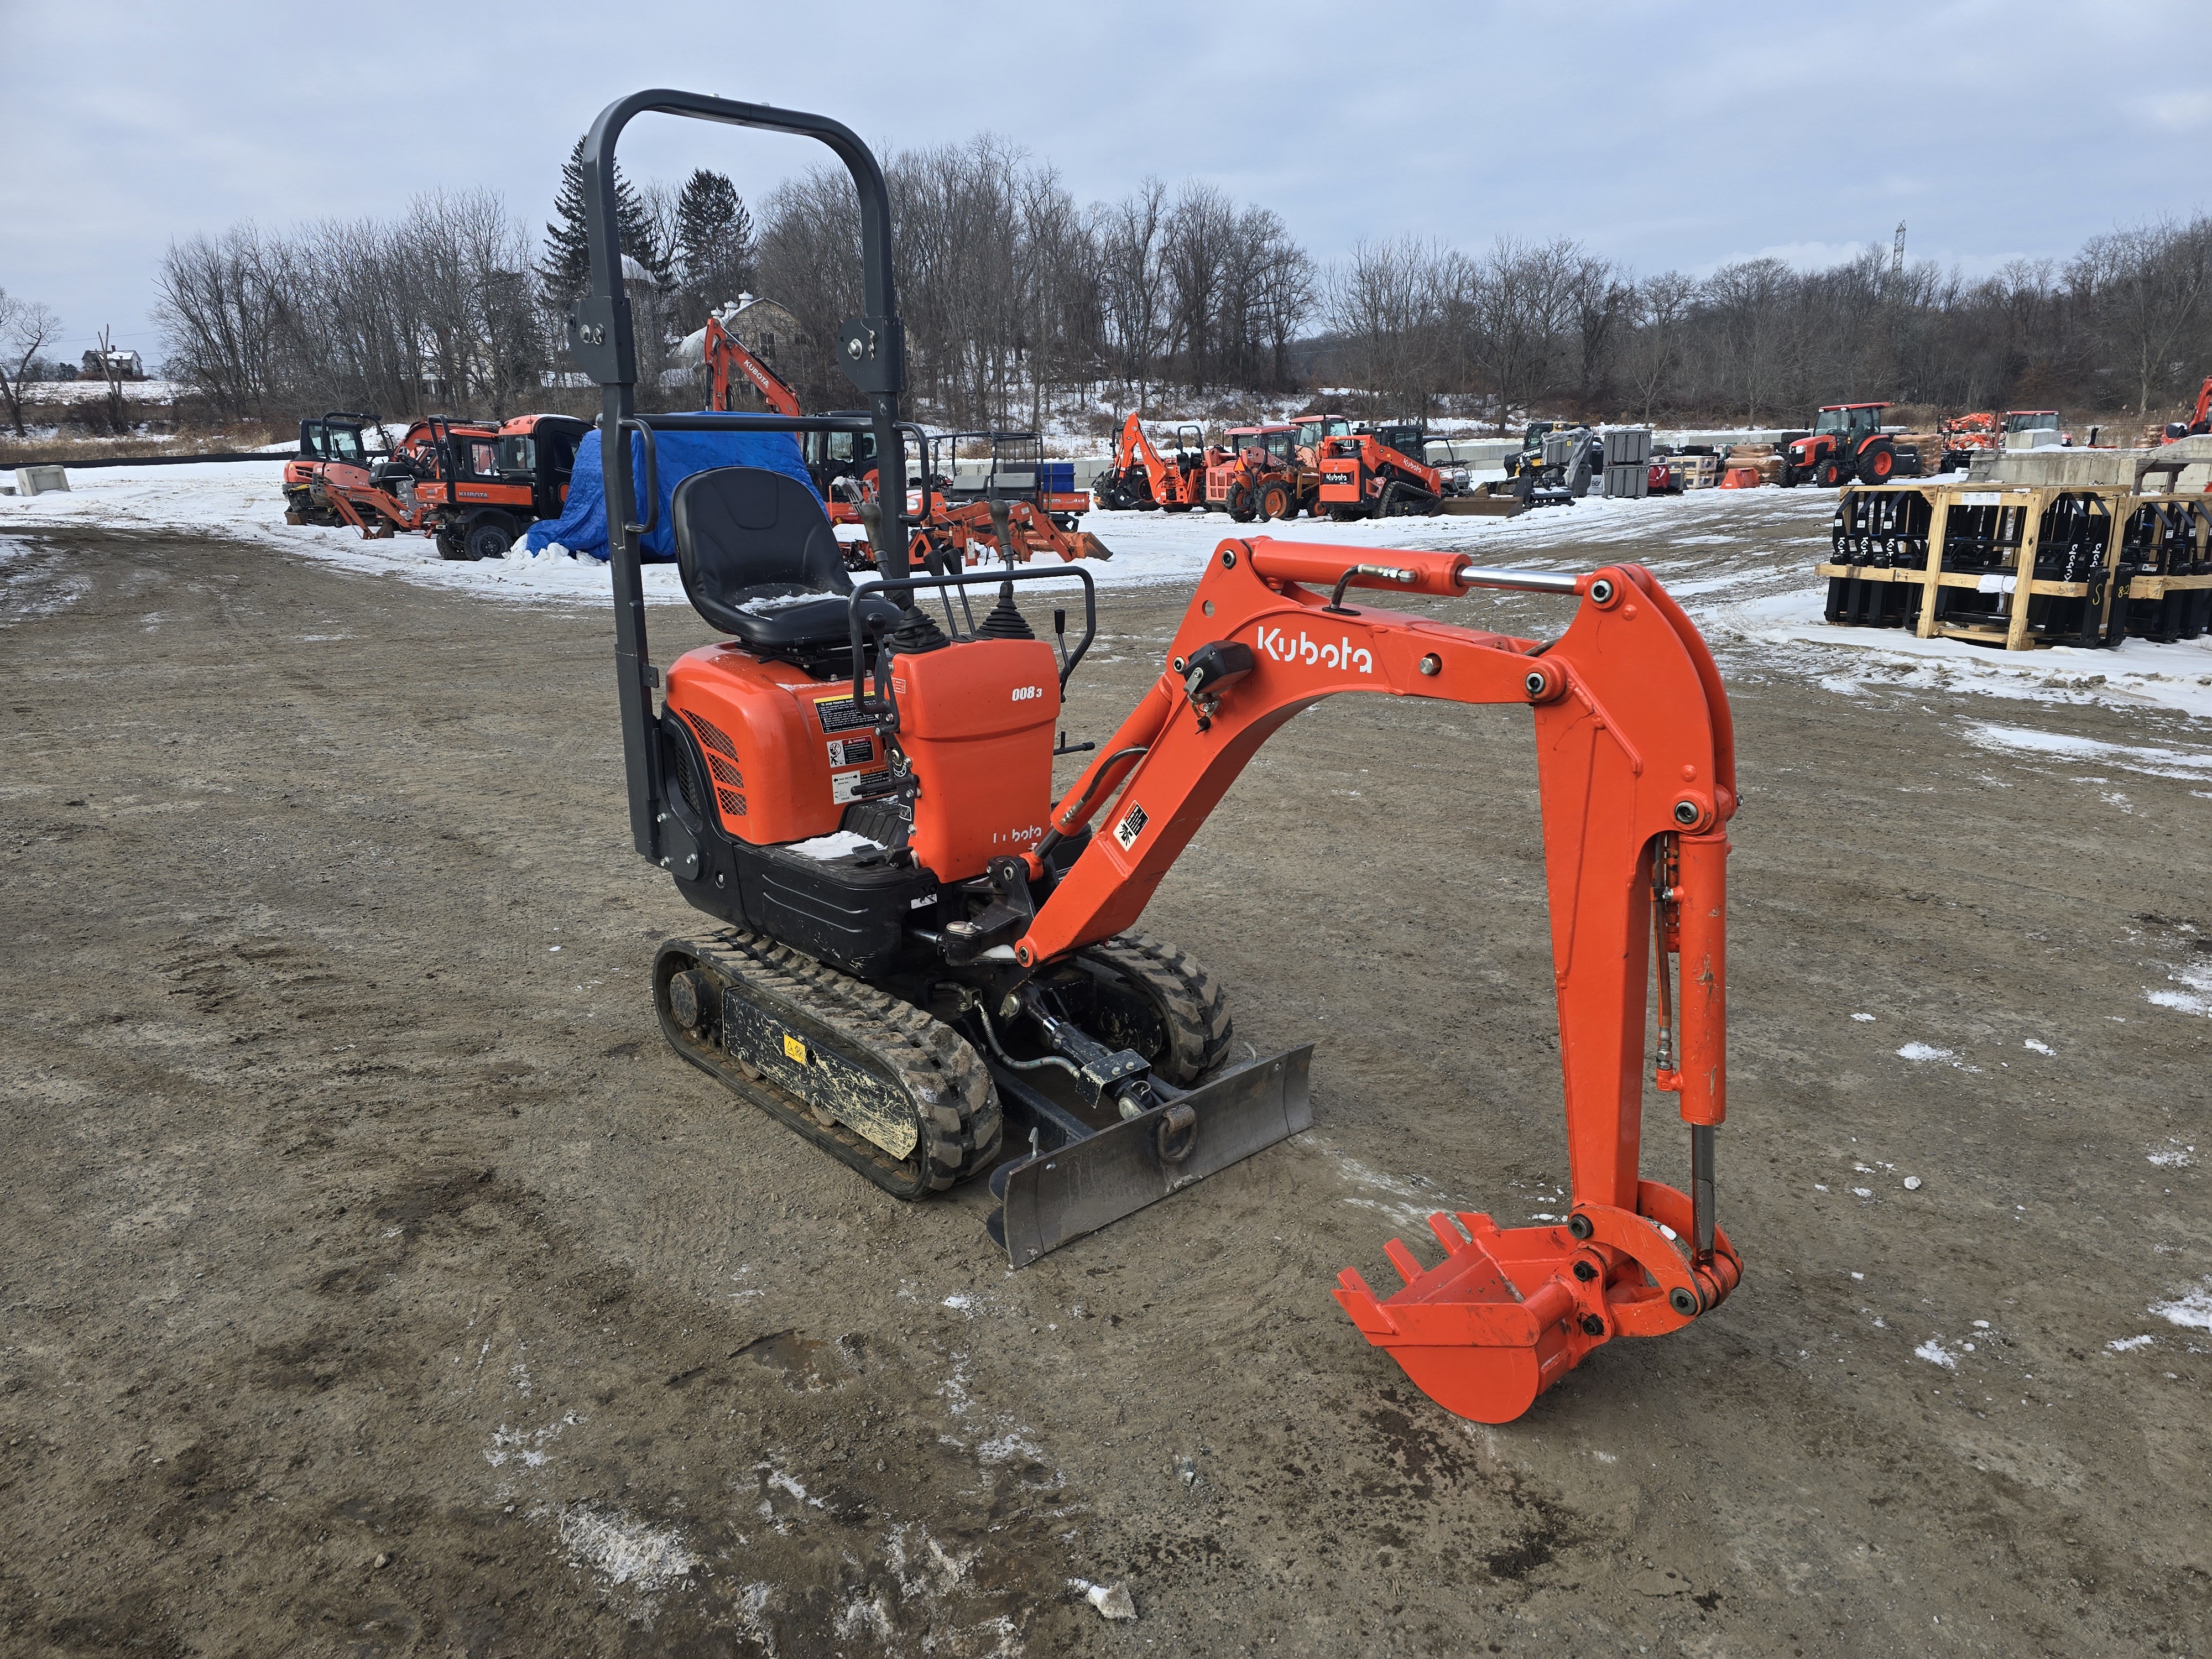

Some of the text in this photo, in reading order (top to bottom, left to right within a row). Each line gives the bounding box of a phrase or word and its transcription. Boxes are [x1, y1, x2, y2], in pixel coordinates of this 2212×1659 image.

[743, 359, 769, 389] KUBOTA
[1522, 448, 1542, 457] DEERE
[1403, 458, 1422, 473] Kubota
[458, 491, 488, 499] KUBOTA
[2063, 544, 2079, 582] Kubota
[2118, 585, 2130, 598] 8-2
[1258, 625, 1373, 674] Kubota
[1011, 686, 1042, 701] 008 3
